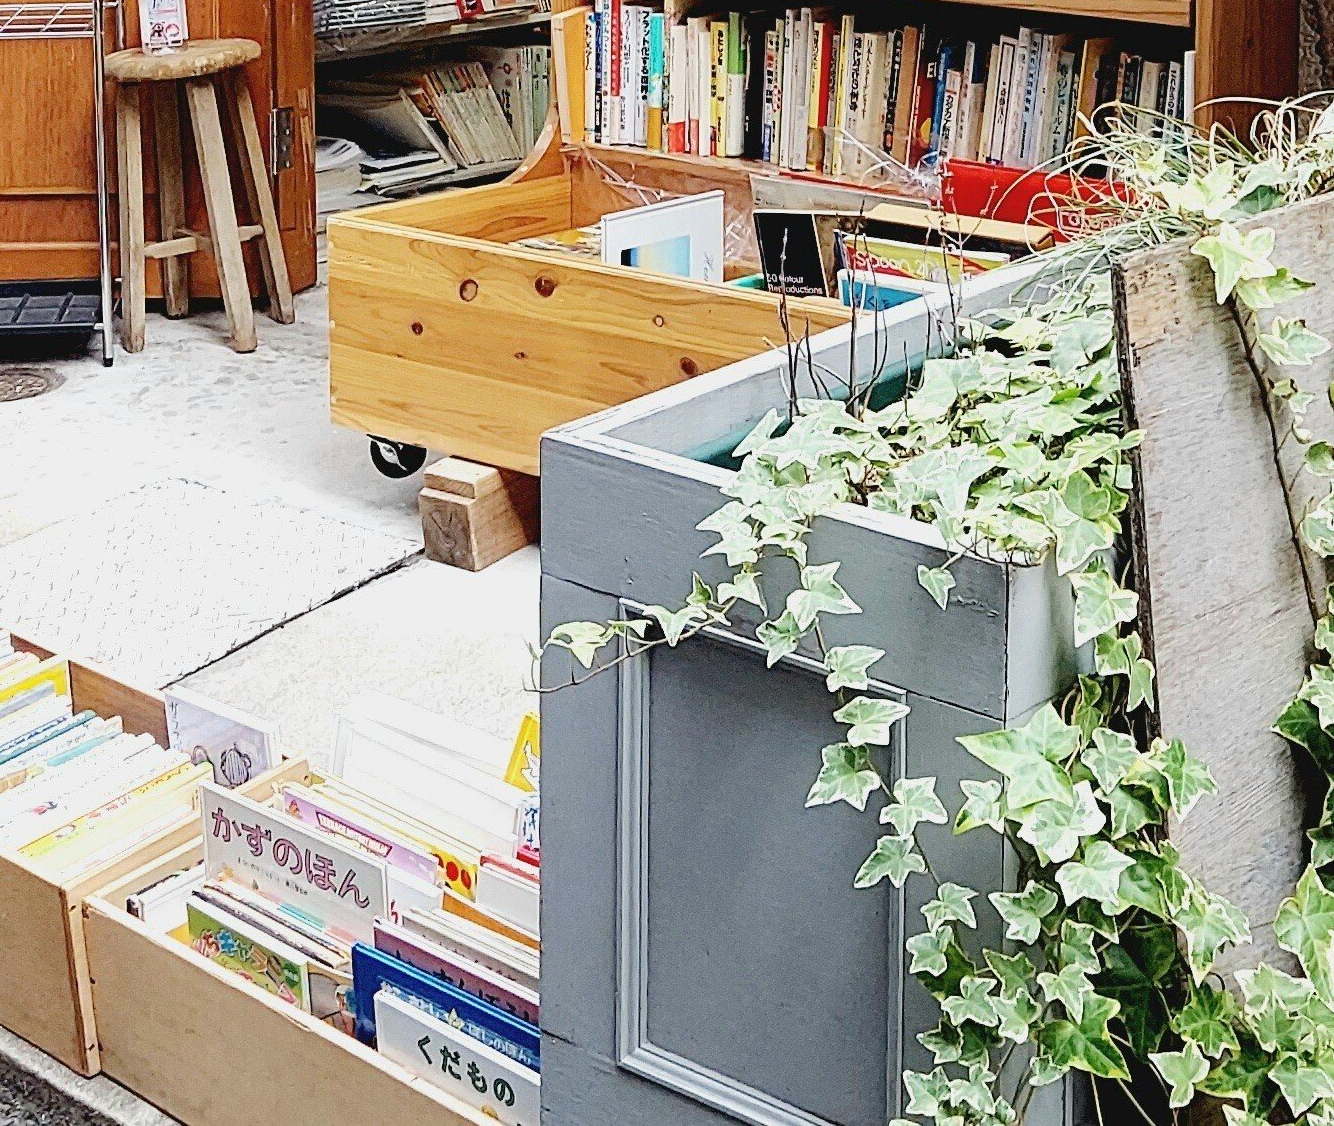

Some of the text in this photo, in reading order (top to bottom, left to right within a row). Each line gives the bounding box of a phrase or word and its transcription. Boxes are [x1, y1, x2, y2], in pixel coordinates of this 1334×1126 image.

[211, 807, 370, 909] かずのほん
[417, 1035, 516, 1107] くだもの
